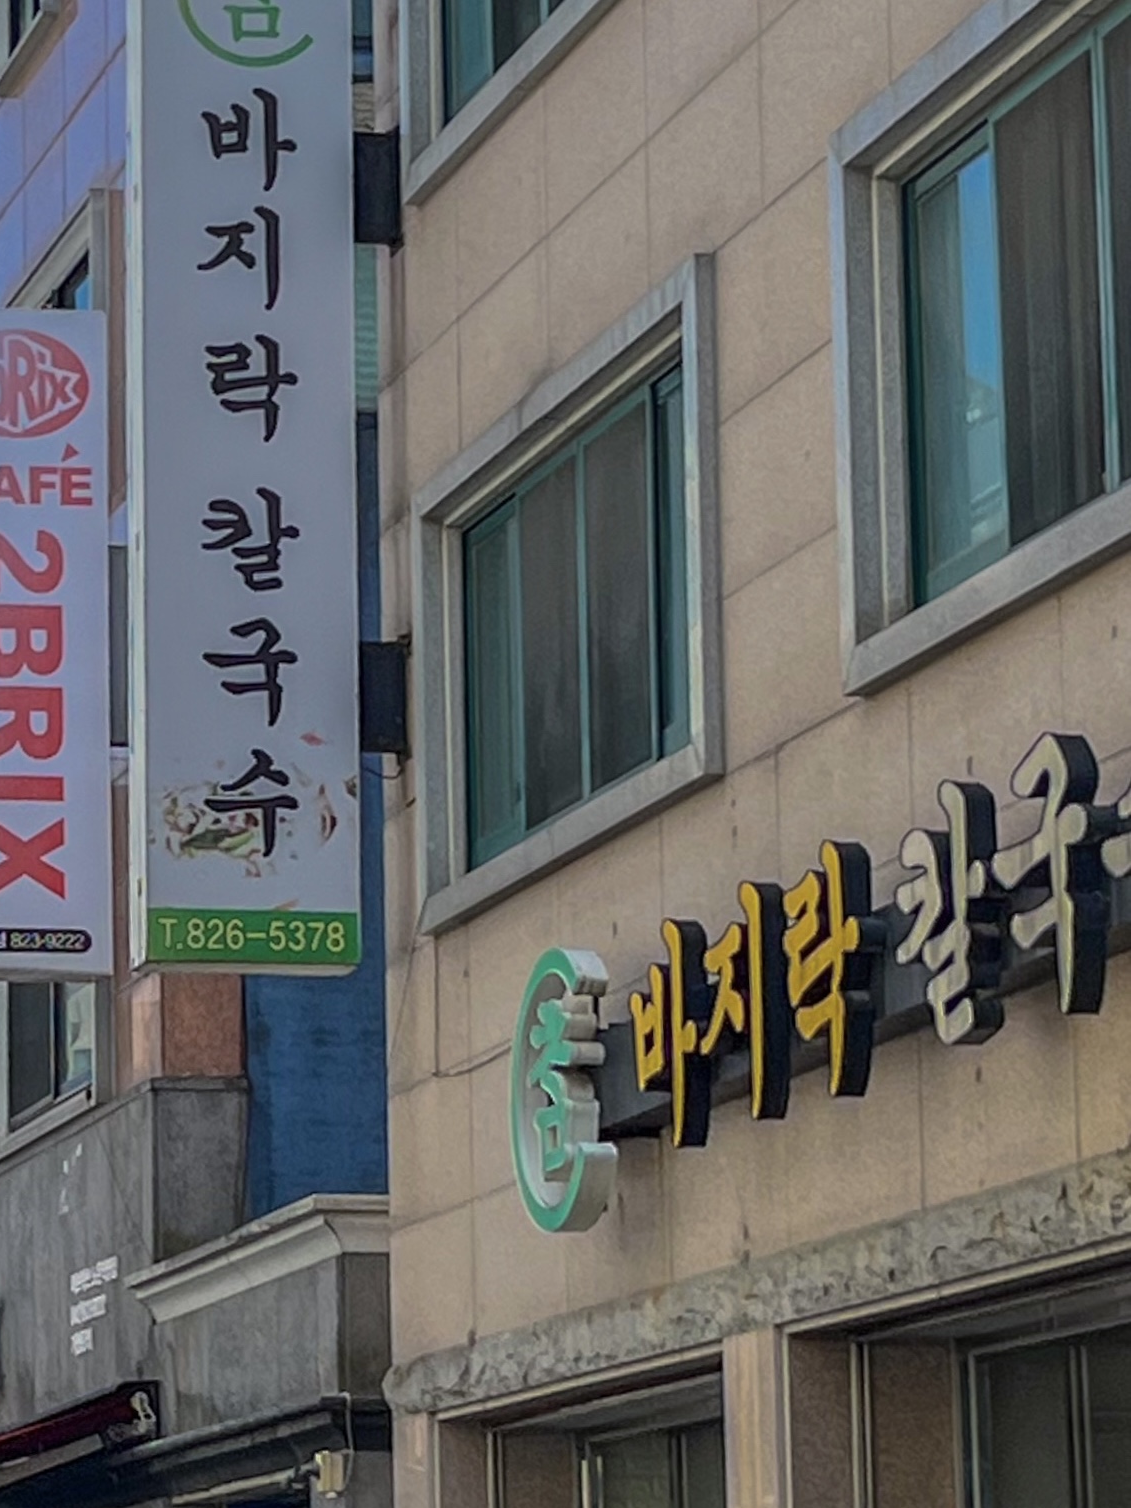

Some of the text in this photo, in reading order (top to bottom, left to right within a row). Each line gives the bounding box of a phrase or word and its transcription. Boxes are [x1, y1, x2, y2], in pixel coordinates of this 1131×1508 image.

[197, 87, 298, 443] 바지락
[201, 487, 300, 857] 칼국수
[156, 917, 347, 953] T.826-5378
[628, 840, 861, 1148] 바지락
[895, 731, 1131, 1045] 칼국
